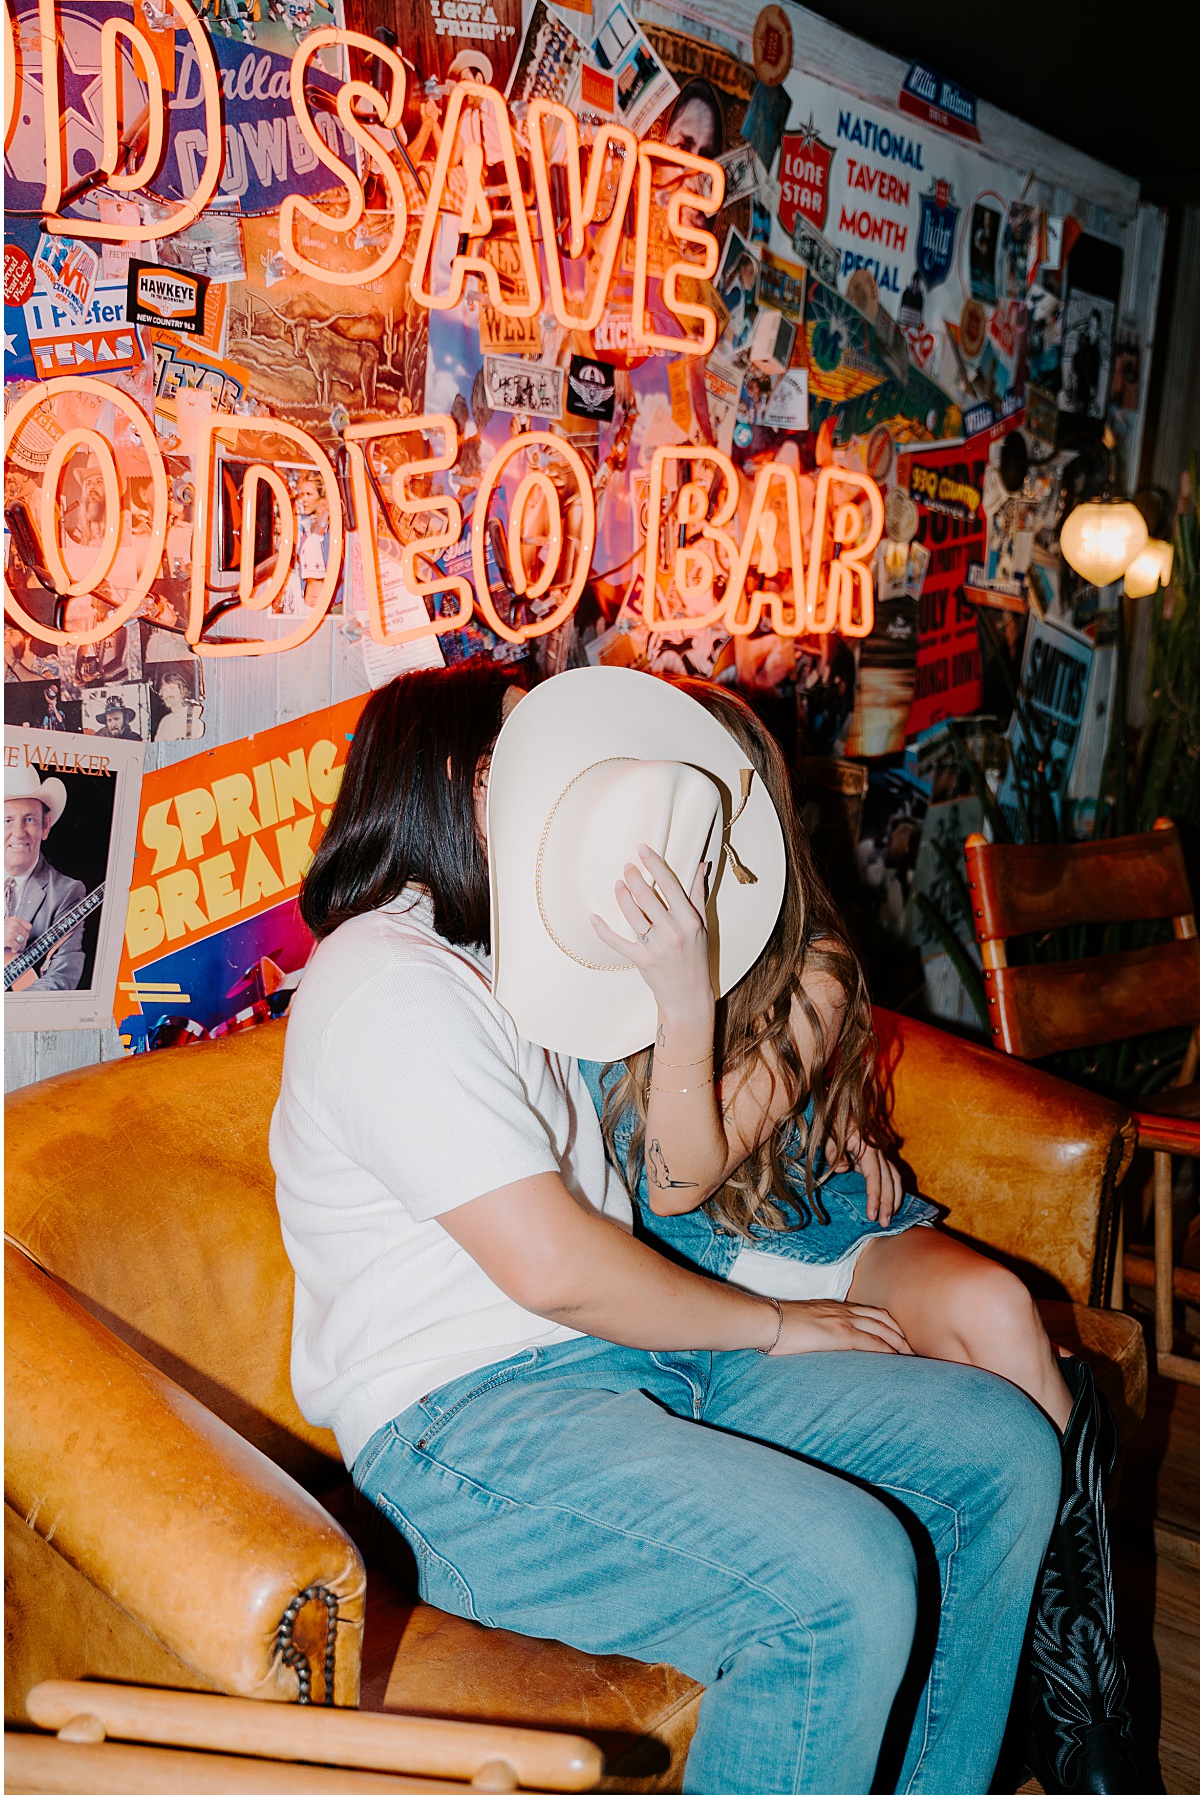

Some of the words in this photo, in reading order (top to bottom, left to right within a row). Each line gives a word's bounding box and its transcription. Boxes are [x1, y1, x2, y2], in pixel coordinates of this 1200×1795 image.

[442, 2, 482, 22] GOT
[483, 6, 499, 24] A
[168, 42, 293, 109] Dalla
[836, 107, 925, 171] NATIONAL
[784, 154, 826, 187] LONE
[846, 158, 911, 208] TAVERN
[280, 28, 726, 357] SAVE
[780, 180, 823, 213] STAR
[838, 204, 908, 253] MONTH
[12, 272, 33, 303] Picker
[140, 277, 195, 301] HAWKEYE
[136, 313, 153, 323] NEW
[152, 315, 184, 329] COUNTRY
[33, 335, 135, 369] TEXAS
[642, 444, 886, 639] BAR
[22, 743, 112, 778] WALKER
[140, 737, 348, 876] SPRING
[122, 812, 320, 960] BREAK
